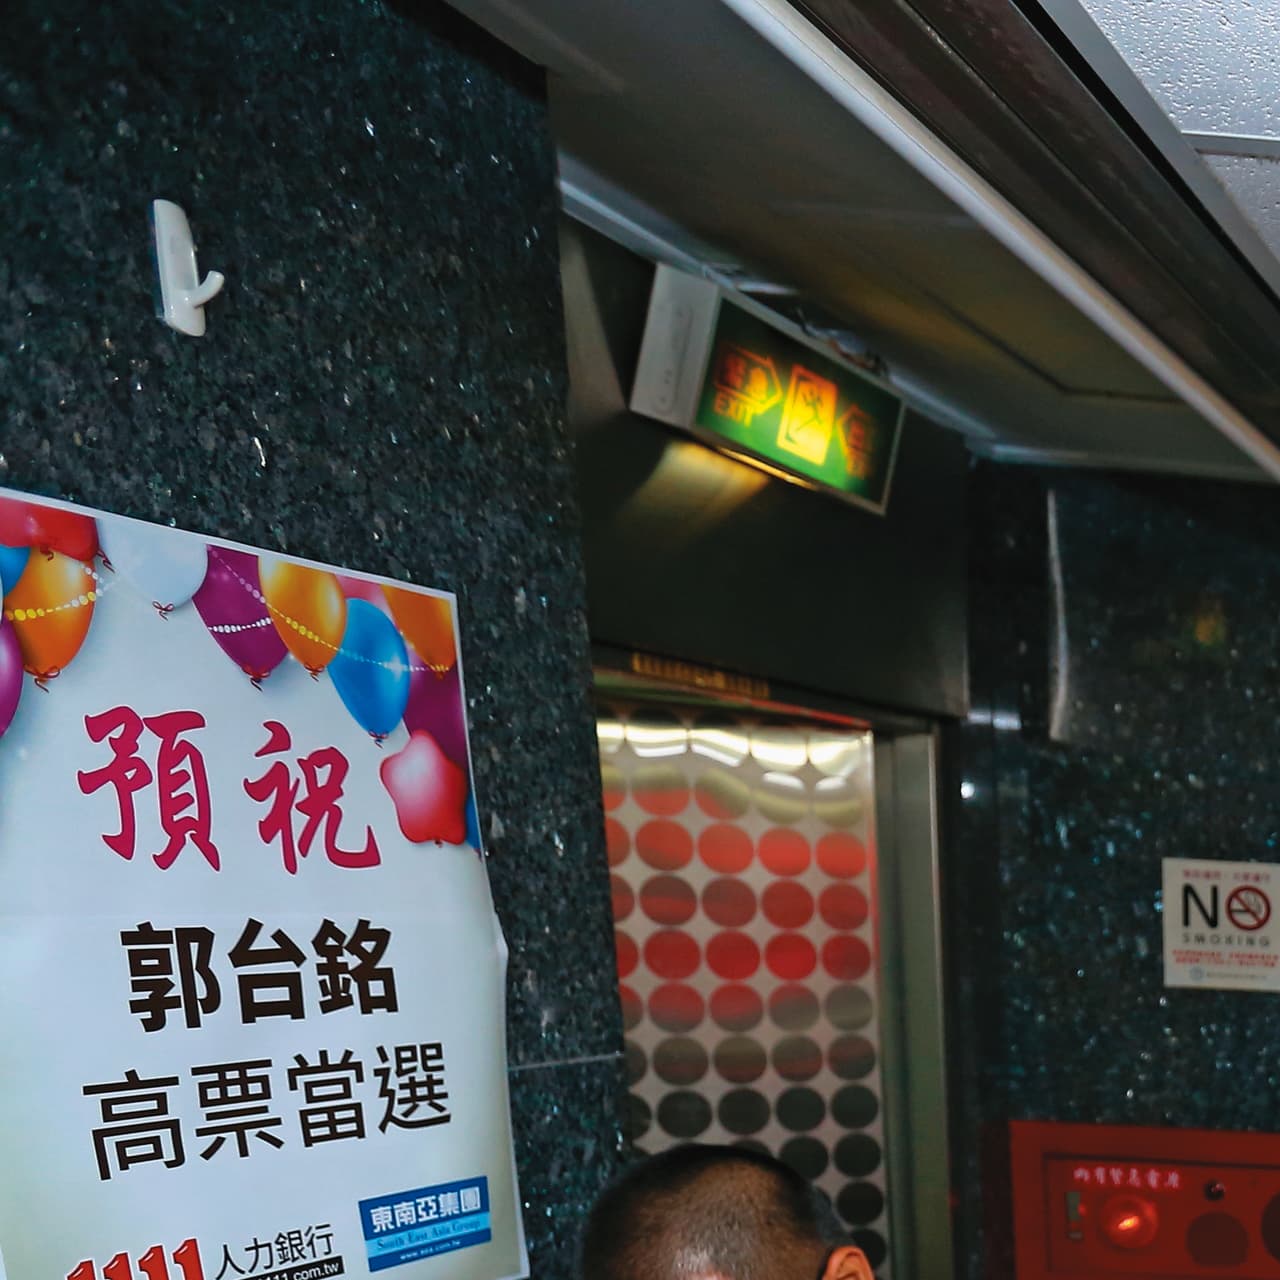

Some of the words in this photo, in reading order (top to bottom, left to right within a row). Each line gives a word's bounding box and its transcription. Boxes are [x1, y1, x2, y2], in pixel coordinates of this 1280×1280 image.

[713, 392, 755, 428] EXIT
[77, 705, 382, 875] 預祝
[1183, 933, 1270, 947] SMOKING
[120, 918, 399, 1032] 郭台銘
[82, 1042, 451, 1181] 高票當選
[369, 1186, 481, 1233] 東南亞集團
[215, 1223, 333, 1280] 人力銀行
